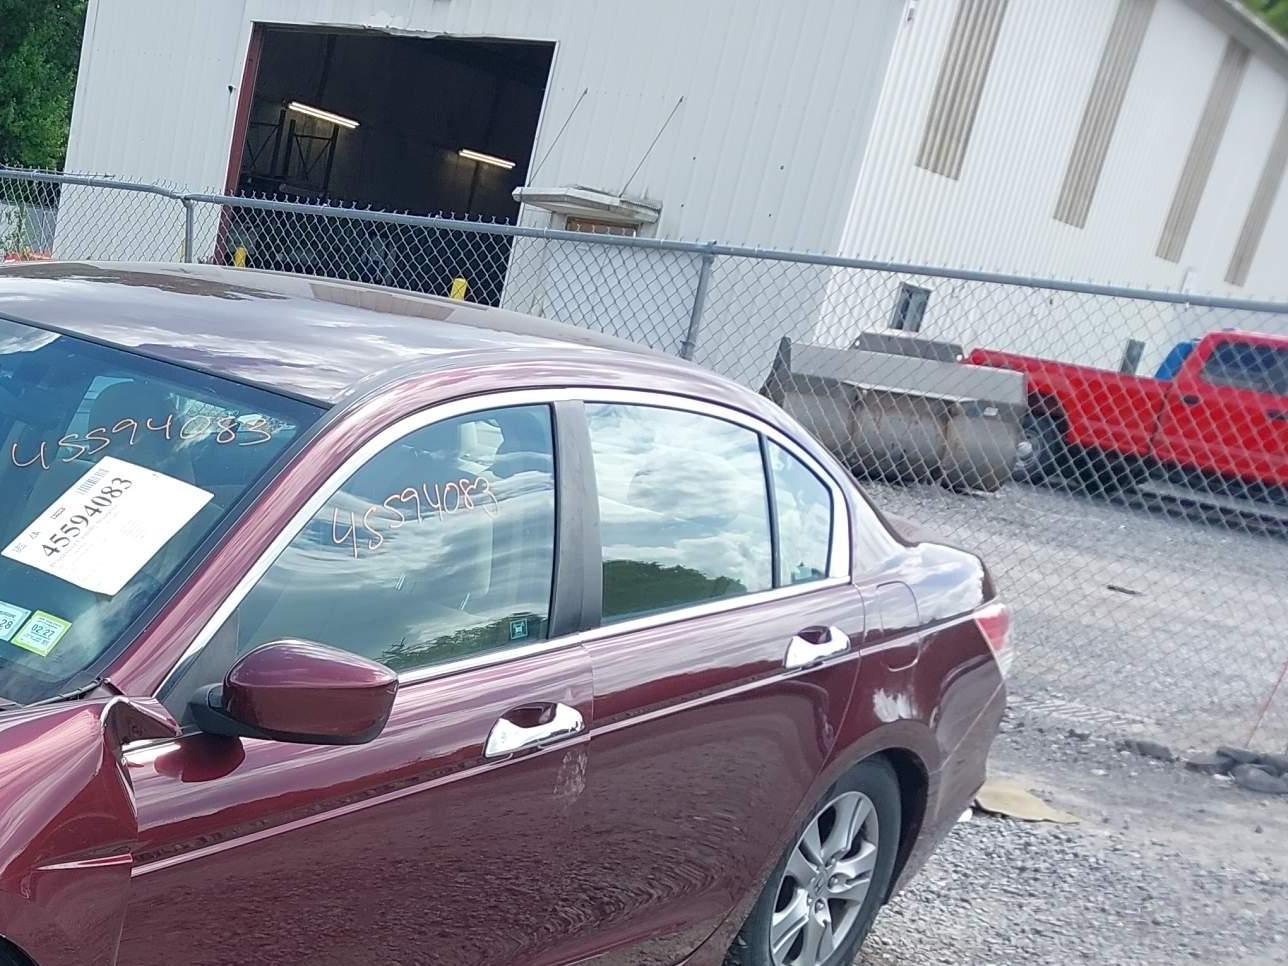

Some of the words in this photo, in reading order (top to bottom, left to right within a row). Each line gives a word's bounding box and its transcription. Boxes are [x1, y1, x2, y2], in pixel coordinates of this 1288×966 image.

[11, 414, 272, 470] 45594083
[41, 477, 133, 558] 45594083
[332, 476, 502, 560] 45594083
